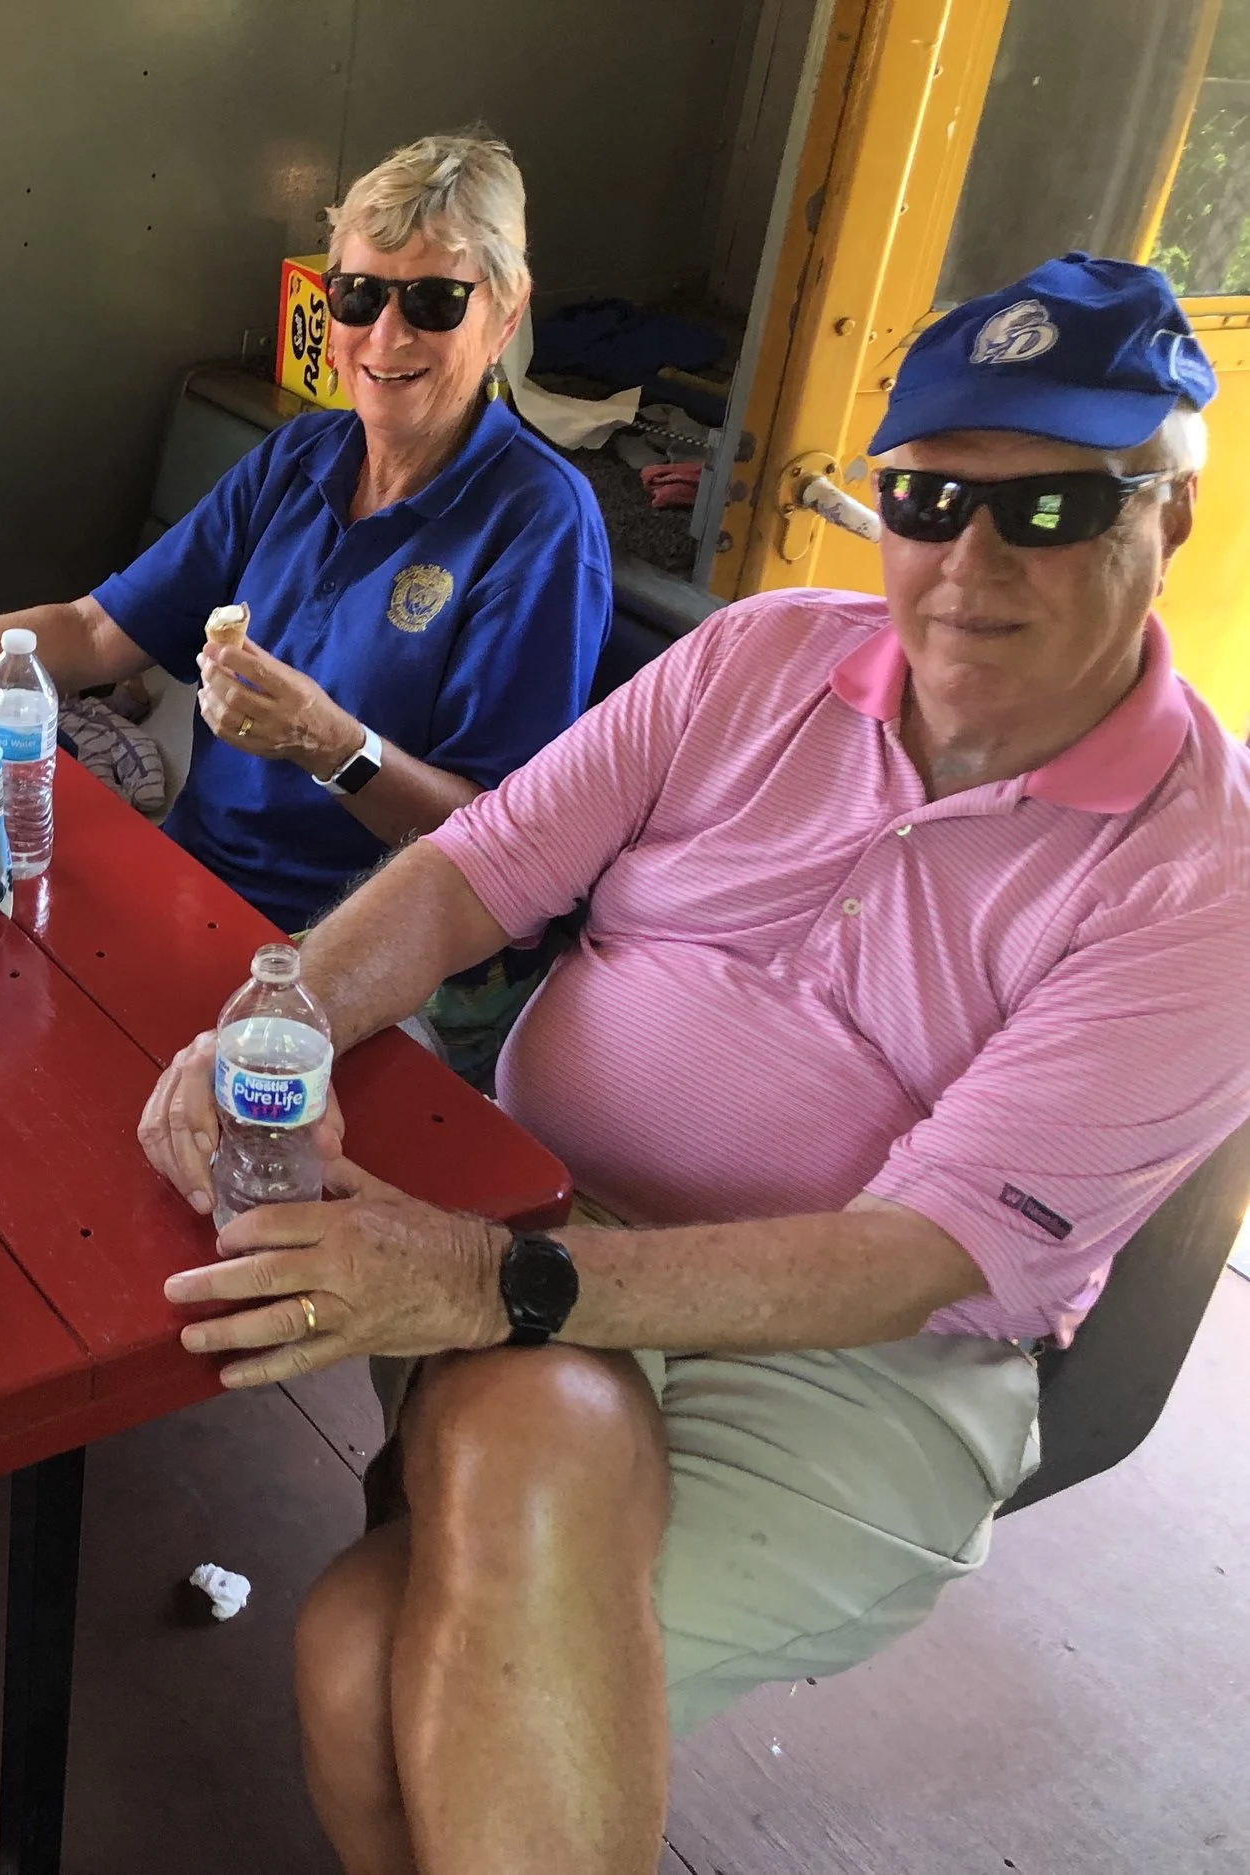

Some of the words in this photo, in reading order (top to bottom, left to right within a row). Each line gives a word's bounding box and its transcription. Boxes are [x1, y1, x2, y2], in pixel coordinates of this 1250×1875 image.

[304, 293, 325, 396] RAGS
[10, 739, 37, 748] Water
[234, 1083, 272, 1105] Pure
[275, 1091, 303, 1112] Life
